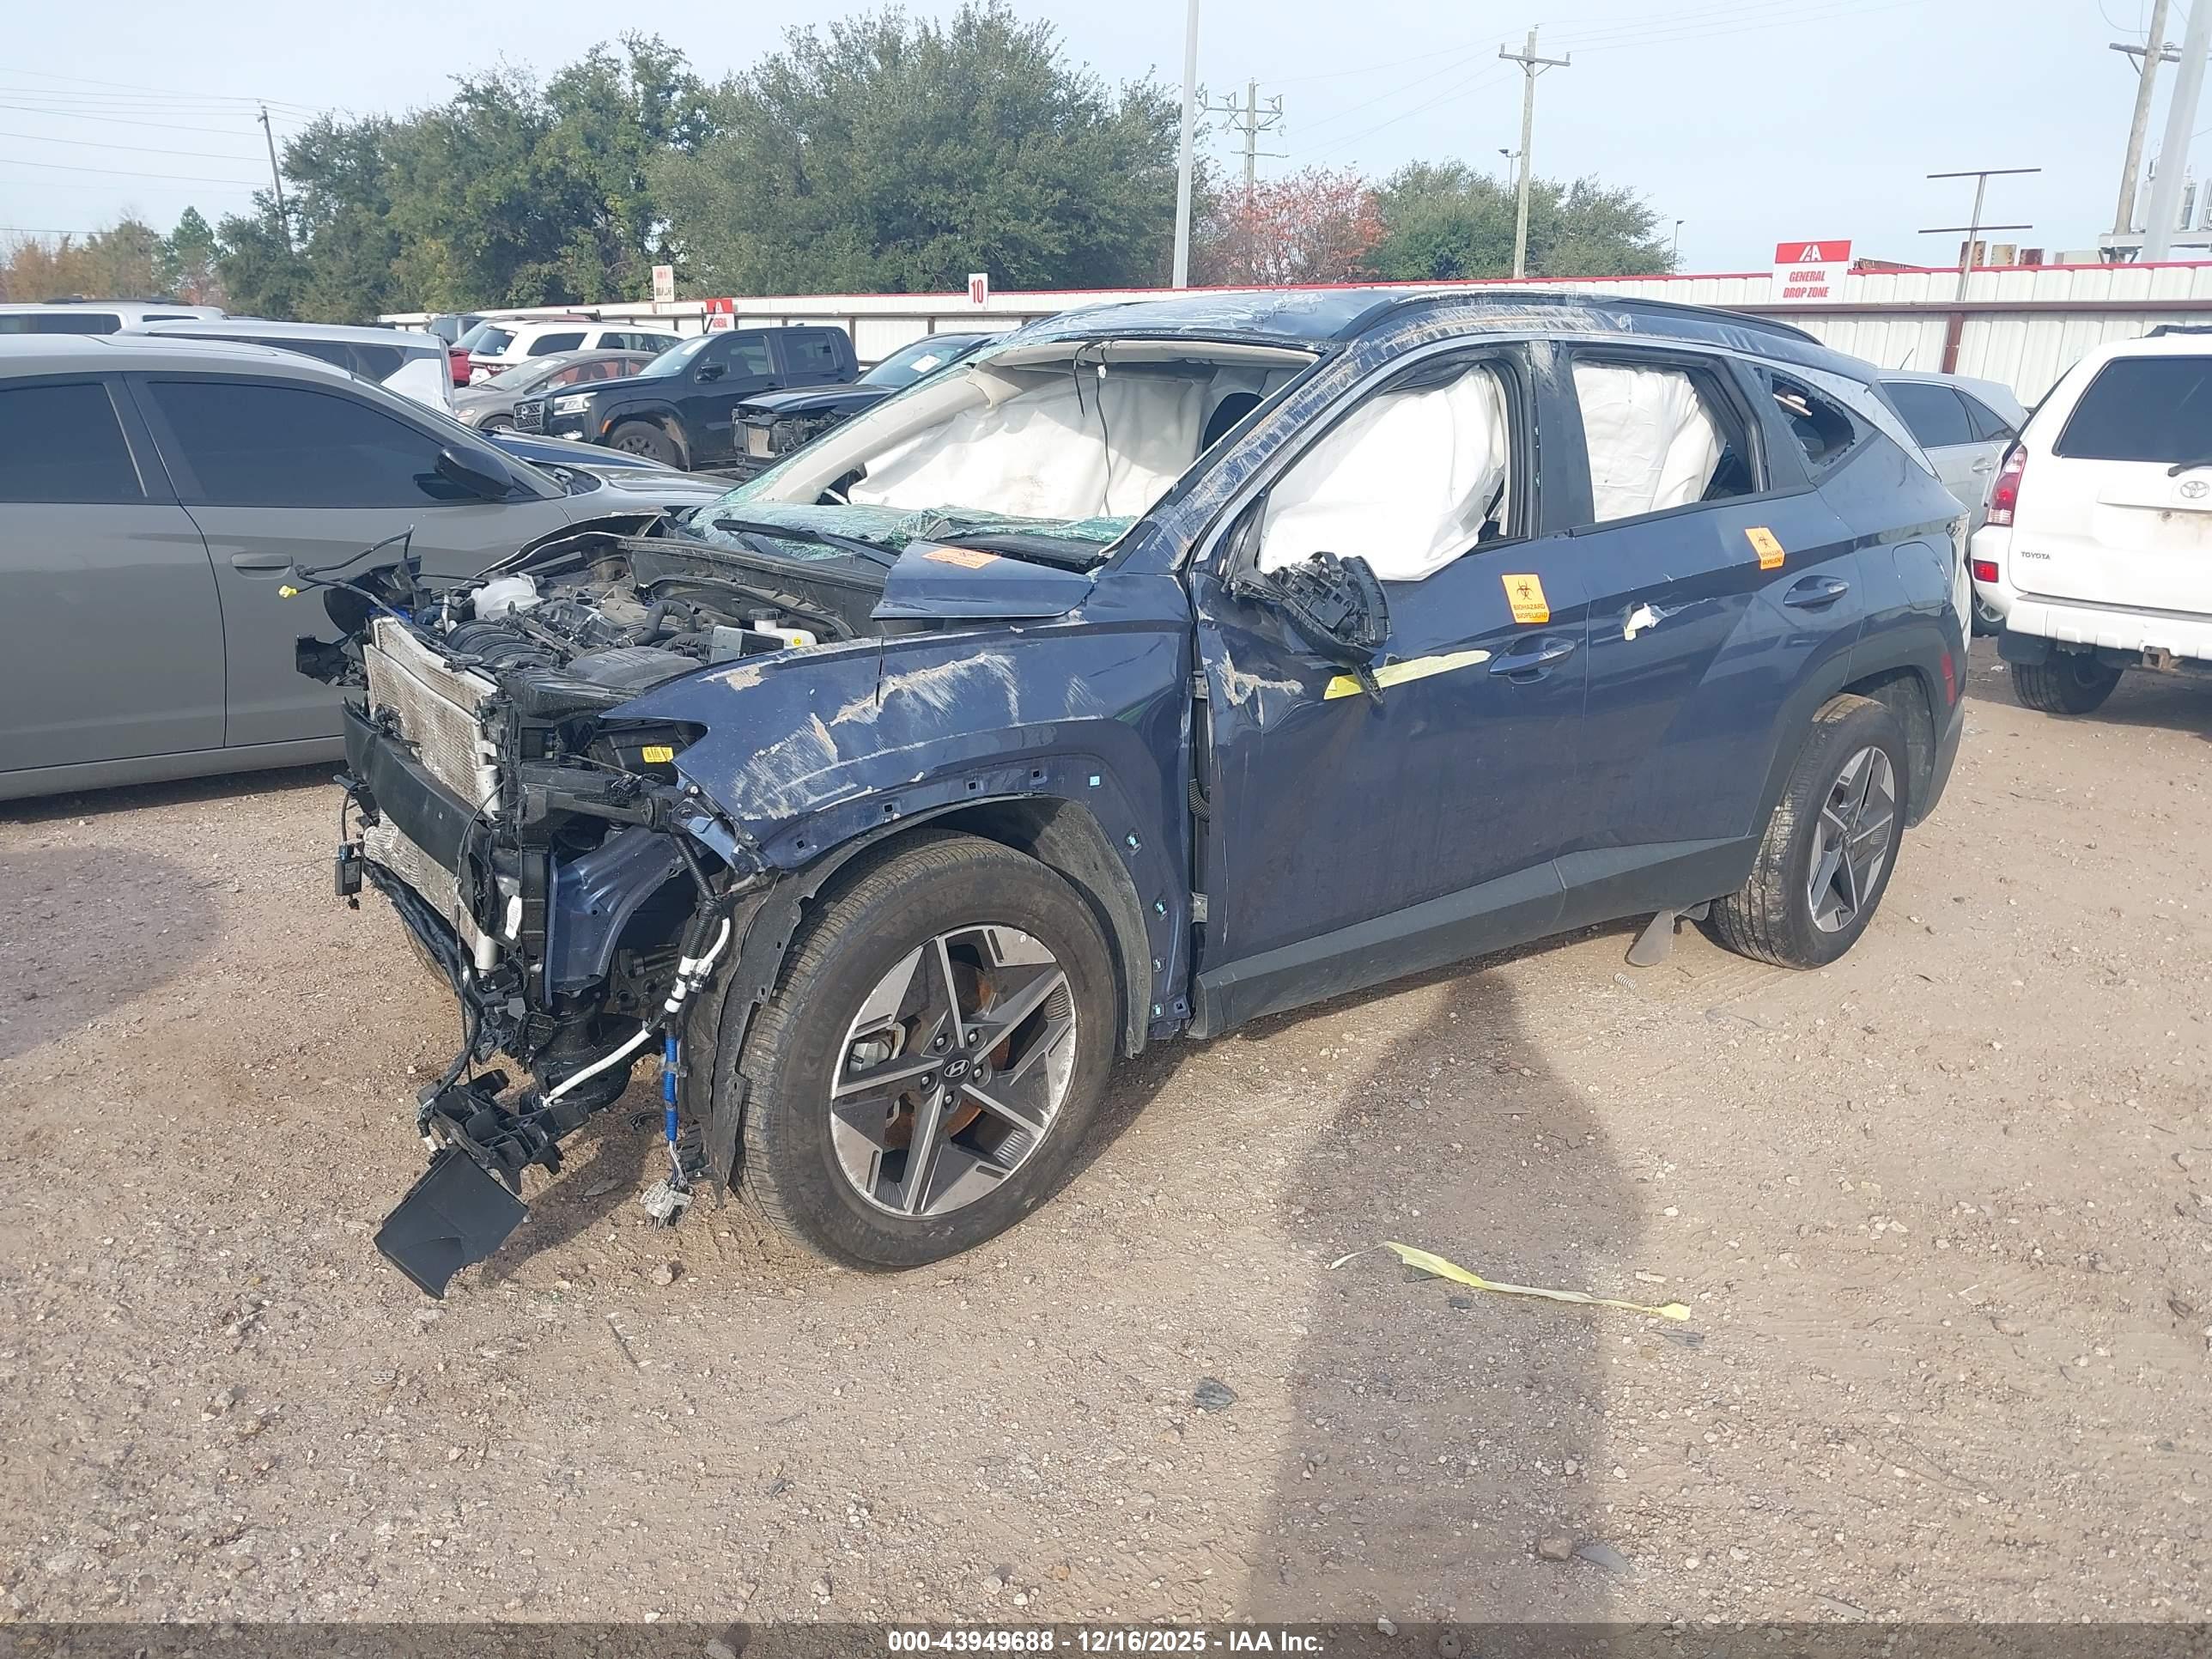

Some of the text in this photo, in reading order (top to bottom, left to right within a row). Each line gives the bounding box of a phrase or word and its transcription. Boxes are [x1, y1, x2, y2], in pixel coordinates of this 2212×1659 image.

[1790, 271, 1825, 282] GENERAL
[970, 279, 984, 304] 10
[1784, 287, 1829, 298] DROP ZONE
